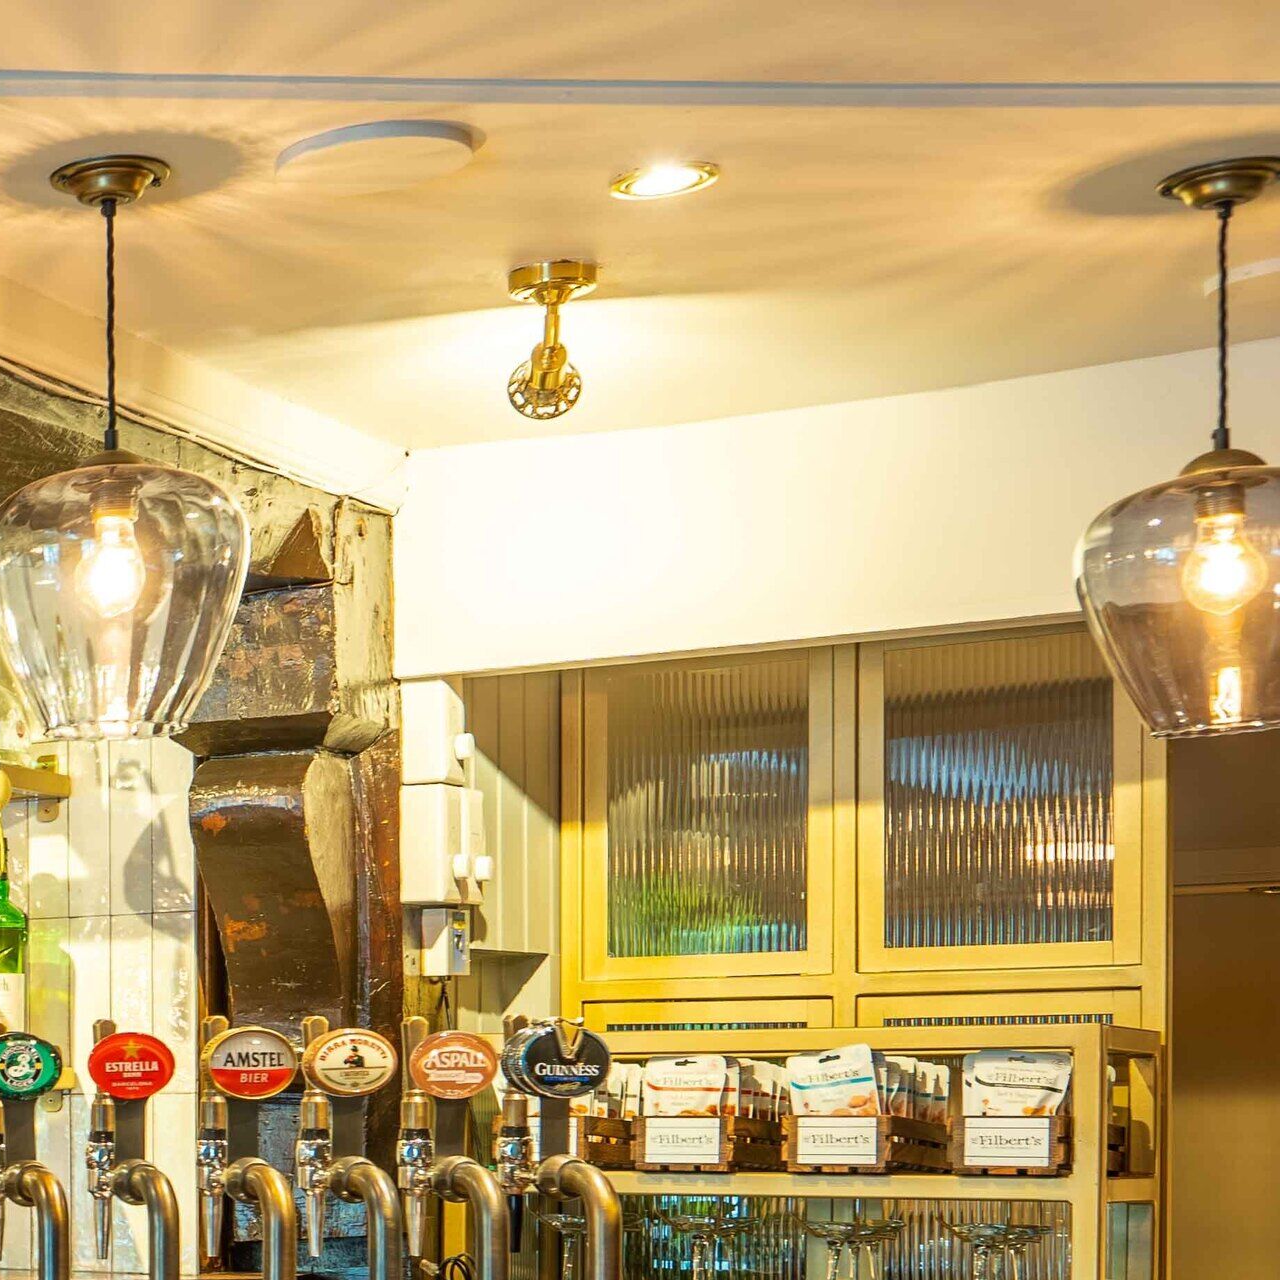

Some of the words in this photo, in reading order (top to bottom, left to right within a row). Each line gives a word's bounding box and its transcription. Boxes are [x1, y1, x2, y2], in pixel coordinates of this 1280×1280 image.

[223, 1051, 284, 1068] AMSTEL
[105, 1060, 159, 1073] ESTRELLA
[534, 1062, 600, 1076] GUINNESS
[240, 1072, 269, 1083] BIER
[659, 1133, 713, 1144] Filbert's
[811, 1134, 870, 1144] Filbert's
[979, 1135, 1042, 1146] Filbert's
